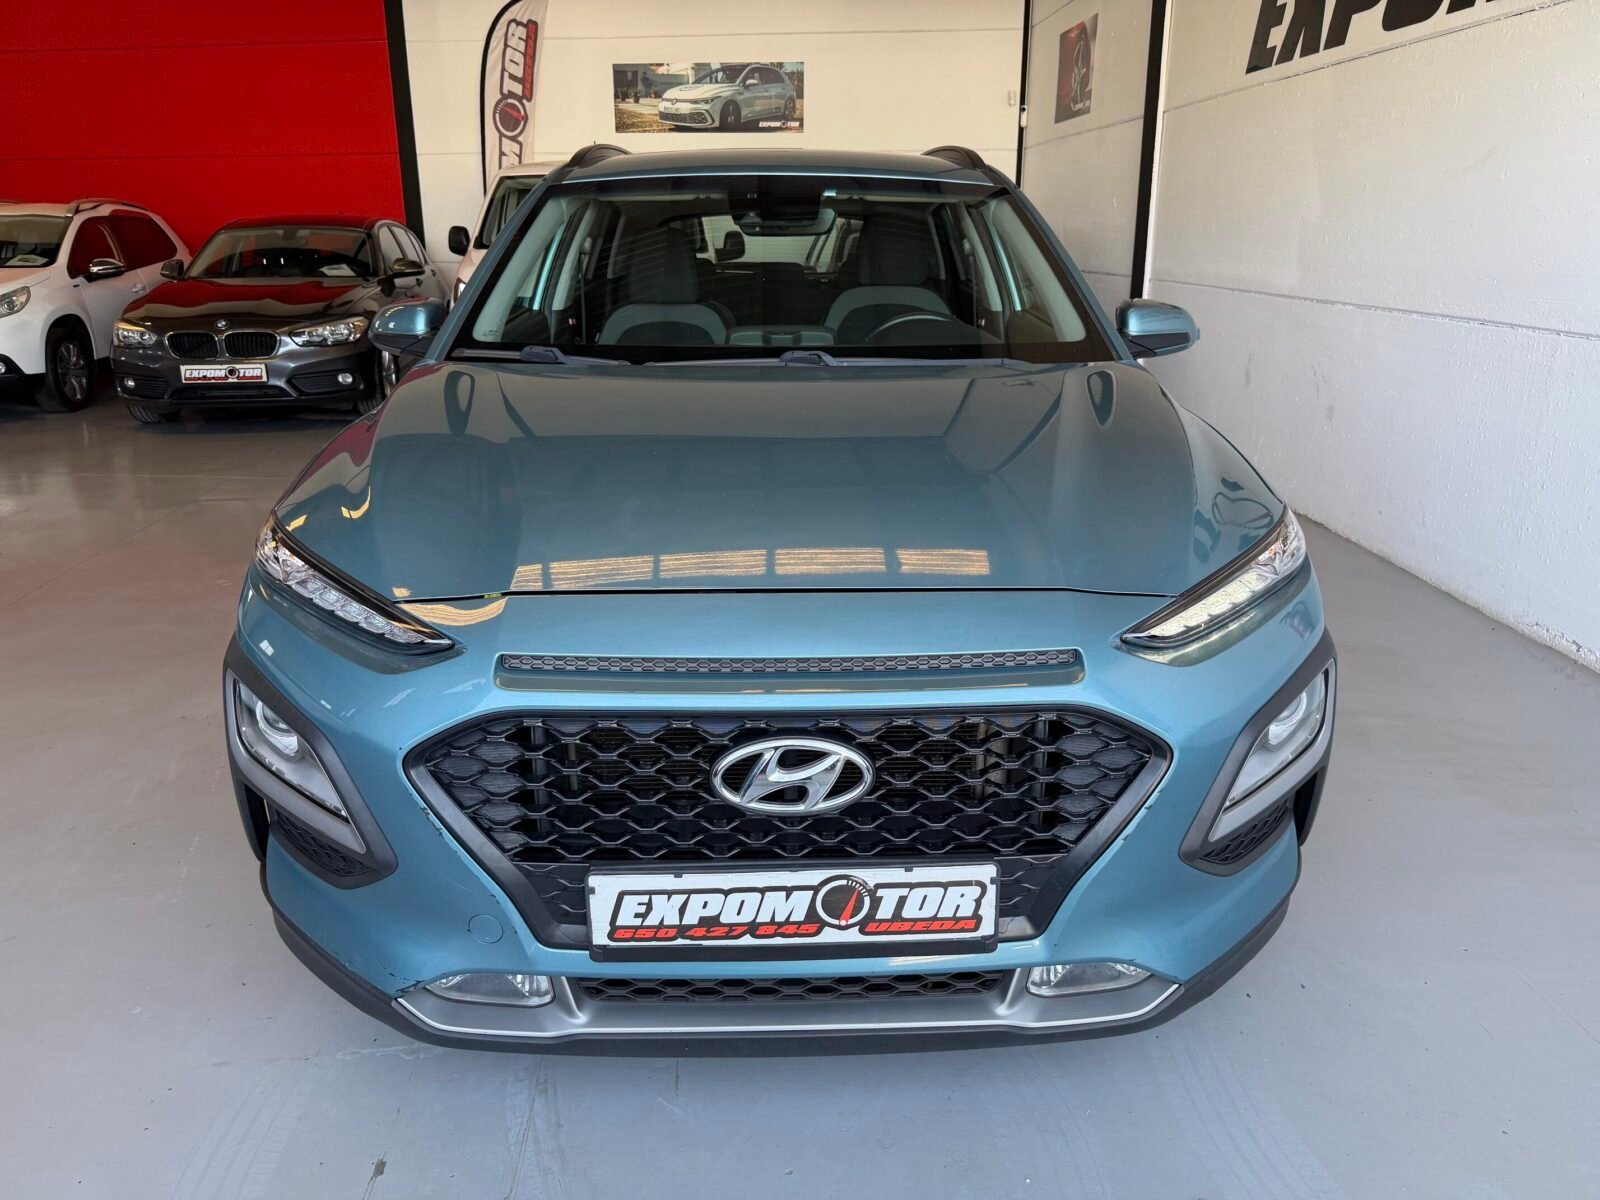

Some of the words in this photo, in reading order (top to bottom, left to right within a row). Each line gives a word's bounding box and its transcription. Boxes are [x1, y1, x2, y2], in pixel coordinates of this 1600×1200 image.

[613, 928, 678, 939] 650
[685, 926, 748, 937] 427
[756, 924, 822, 935] 845
[865, 919, 977, 932] UBEDA
